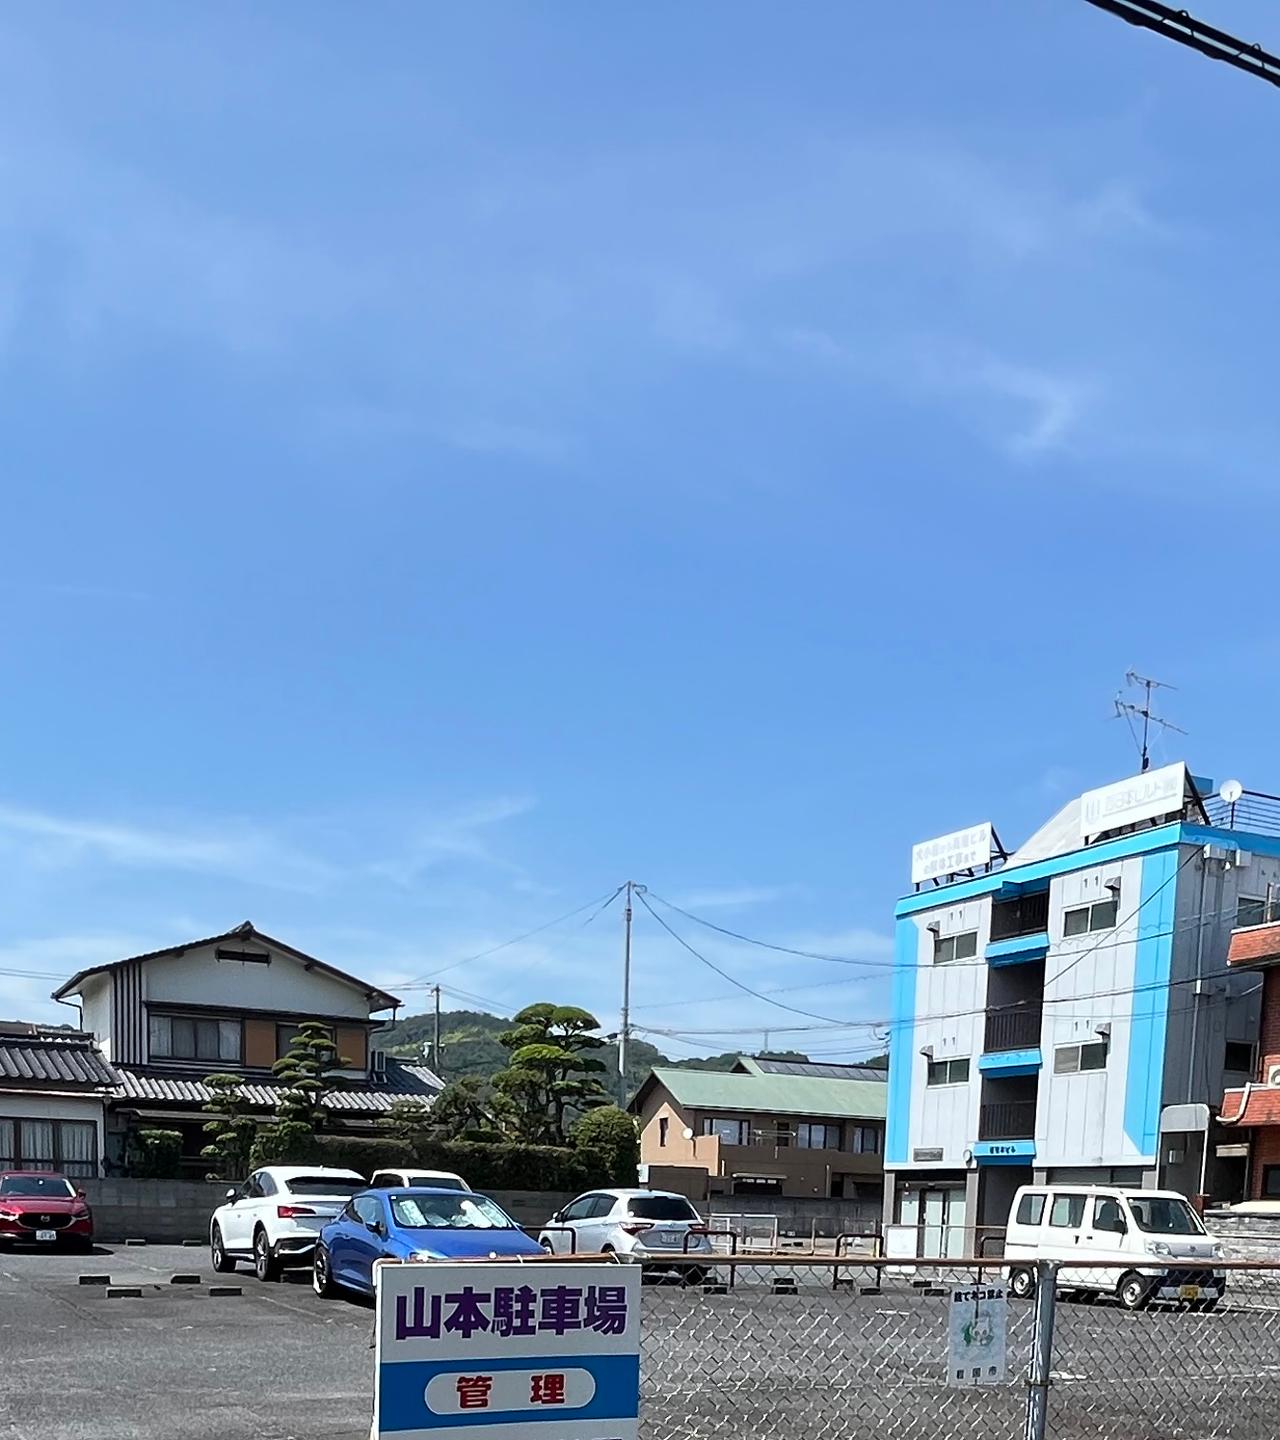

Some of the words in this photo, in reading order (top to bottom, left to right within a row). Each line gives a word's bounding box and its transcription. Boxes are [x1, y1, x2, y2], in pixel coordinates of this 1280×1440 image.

[395, 1285, 628, 1341] 山本駐車場
